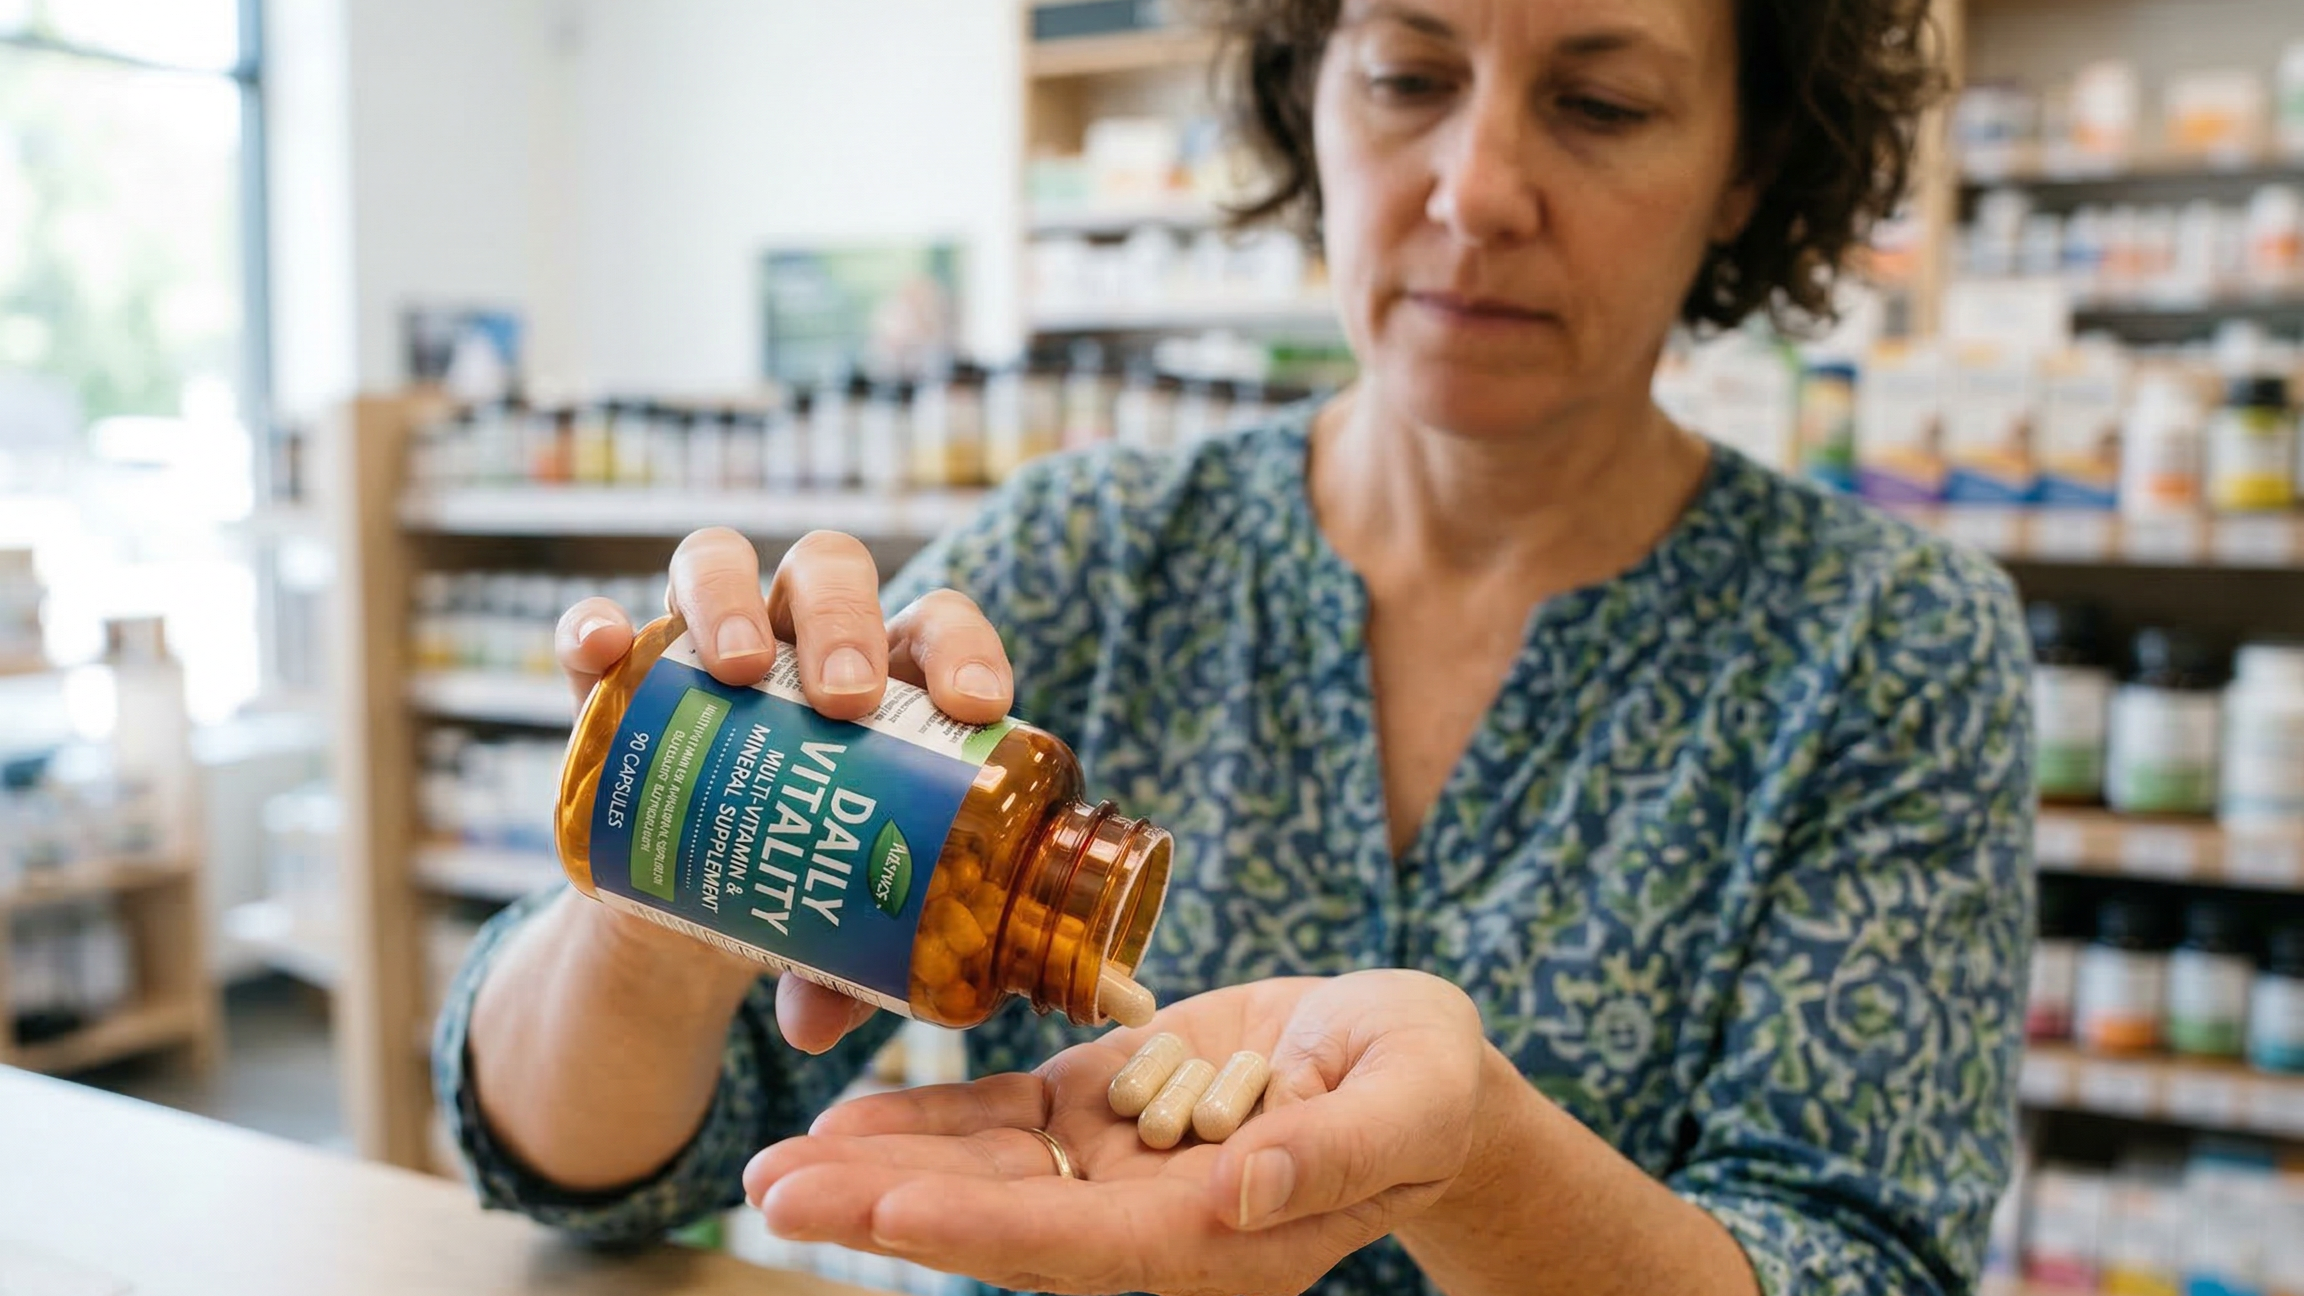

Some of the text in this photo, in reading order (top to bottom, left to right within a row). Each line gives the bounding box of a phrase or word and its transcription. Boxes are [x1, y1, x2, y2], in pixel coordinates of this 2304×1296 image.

[608, 732, 650, 829] 90 CAPSULES
[702, 723, 771, 914] MINERAL SUPPLEMENT
[725, 749, 785, 895] MULTI-VITAMIN &
[751, 741, 848, 936] VITALITY
[801, 787, 877, 927] DAILY
